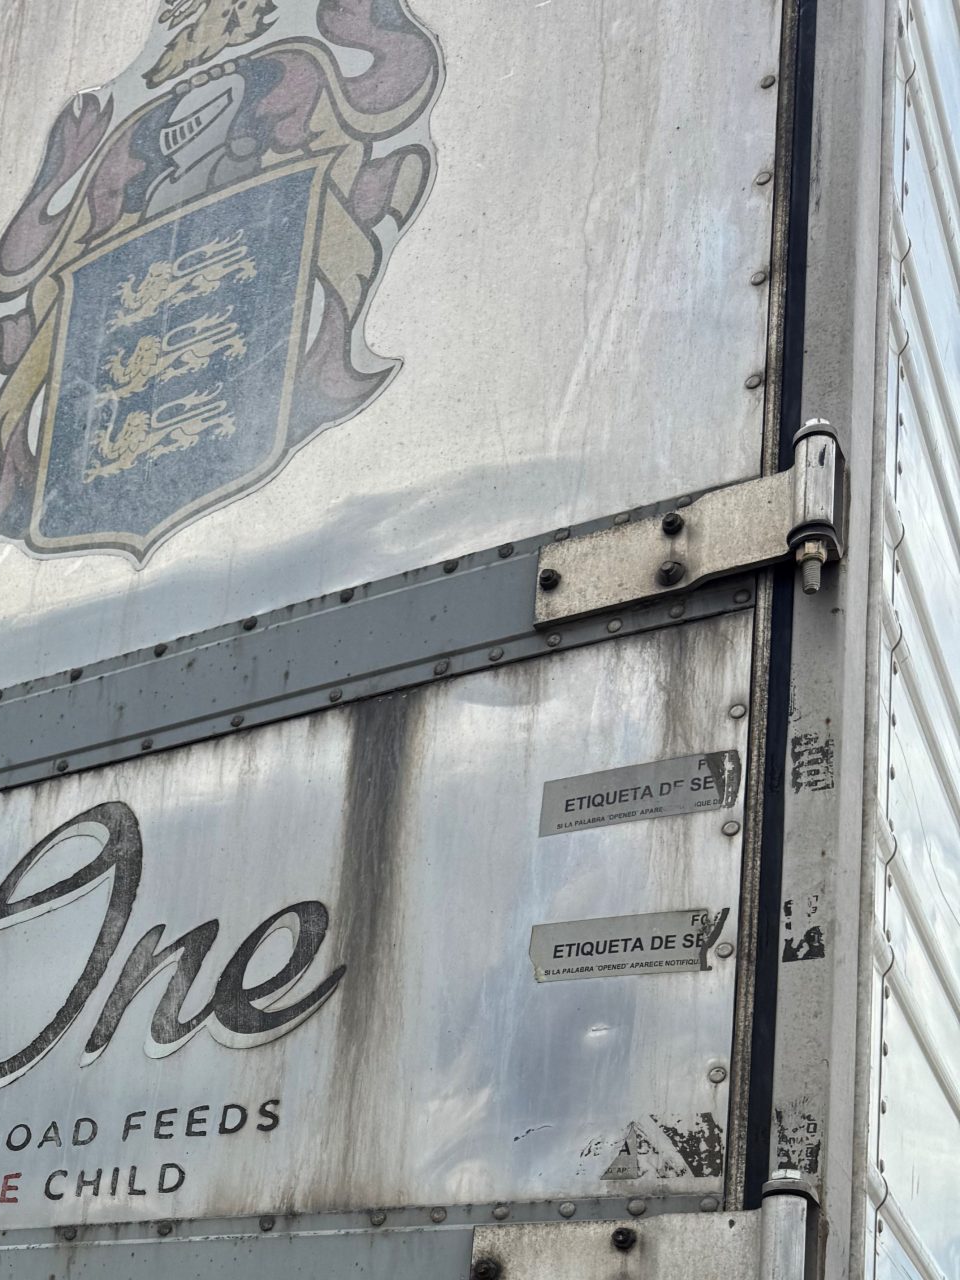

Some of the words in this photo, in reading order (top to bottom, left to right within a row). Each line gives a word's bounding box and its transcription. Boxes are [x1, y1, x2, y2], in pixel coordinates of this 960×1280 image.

[564, 785, 653, 812] ETIQUETA
[552, 937, 644, 959] ETIQUETA
[651, 934, 677, 950] DE
[562, 965, 594, 974] PALABRA
[630, 960, 664, 969] APARECE
[664, 958, 702, 967] NOTIFIQU
[121, 1099, 281, 1141] FEEDS
[44, 1162, 186, 1201] CHILD
